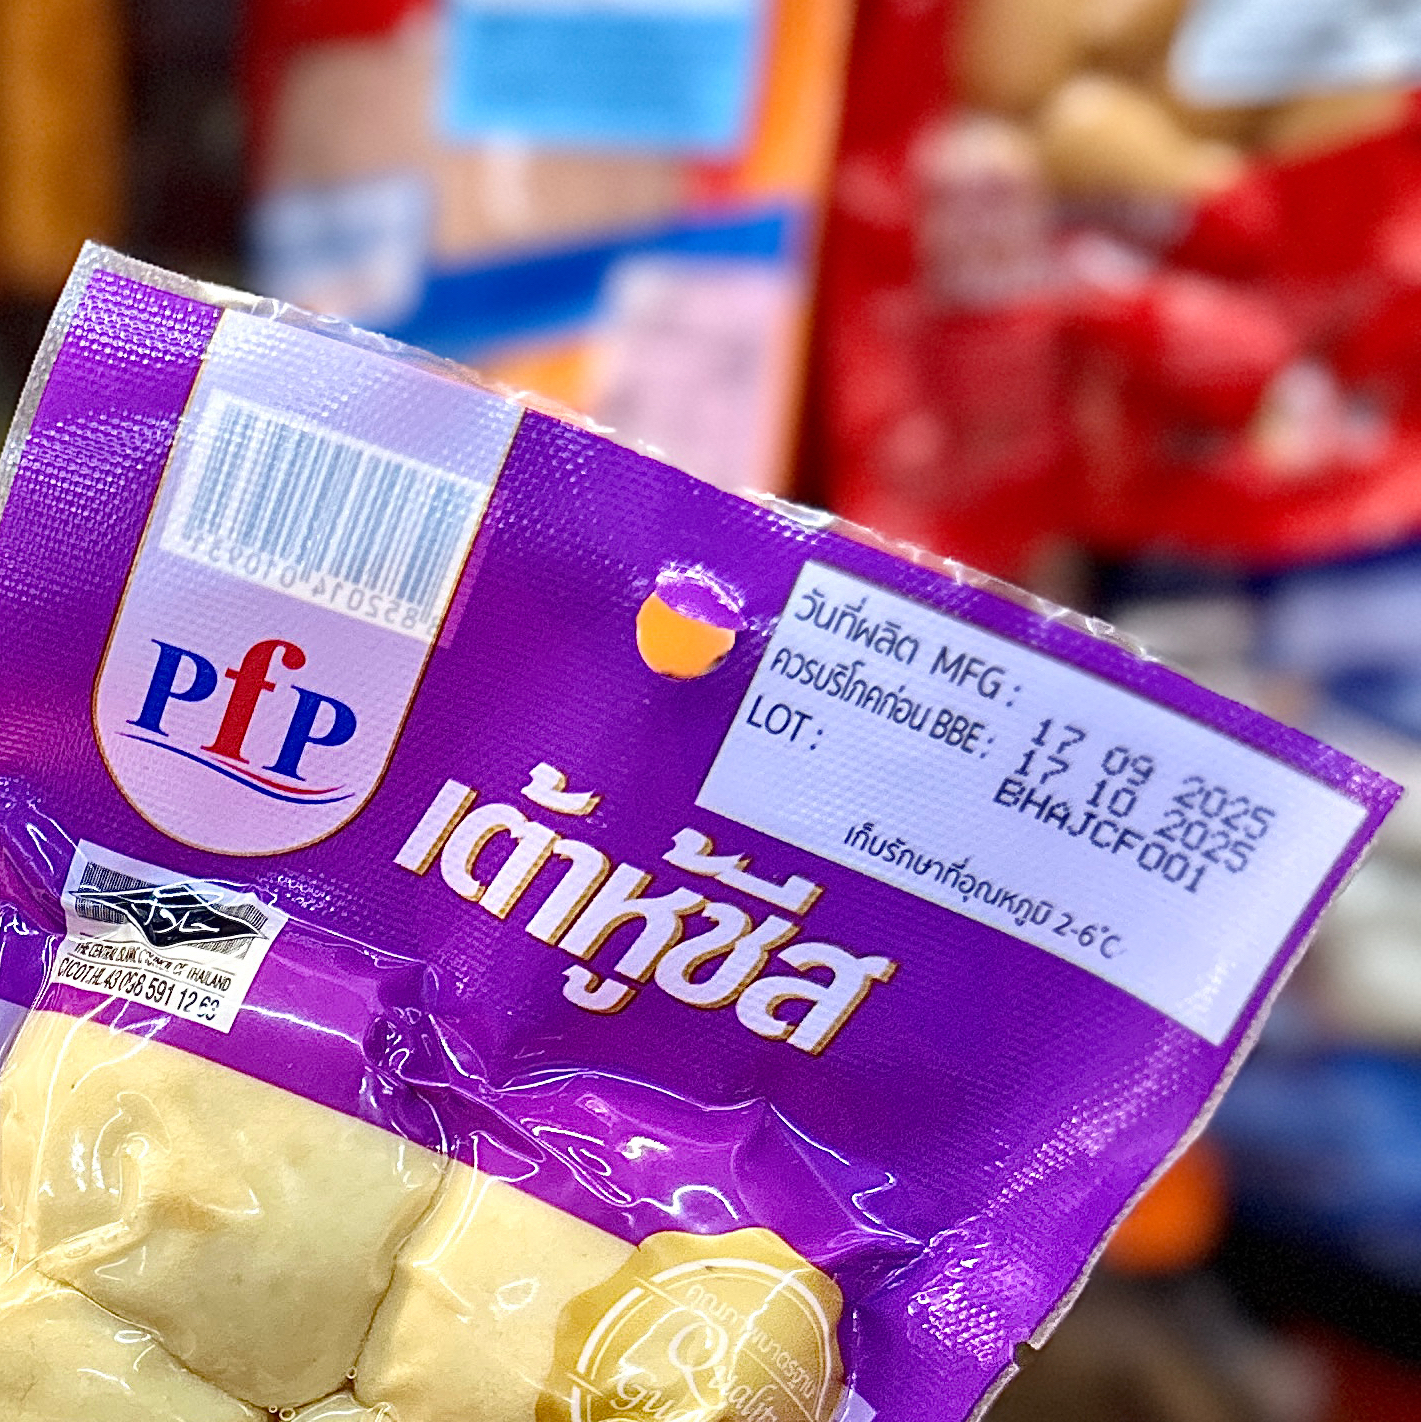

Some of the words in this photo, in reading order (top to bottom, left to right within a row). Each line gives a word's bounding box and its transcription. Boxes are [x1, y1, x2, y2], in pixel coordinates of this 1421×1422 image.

[794, 588, 920, 665] วันที่ผลิต
[126, 638, 358, 782] PfP
[769, 647, 932, 732] ควรบริโภคก่อน
[992, 776, 1208, 893] BHAJCF001
[1014, 749, 1070, 785] 17
[1086, 779, 1138, 818] 10
[1153, 809, 1256, 873] 2025
[1031, 718, 1087, 754] 17
[1101, 746, 1155, 787] 09
[1172, 775, 1276, 840] 2025
[393, 761, 898, 1058] เต้าหู้ชีส
[844, 822, 1054, 927] เก็บรักษาที่อุณหภูมิ
[145, 977, 175, 1007] 591
[176, 987, 198, 1013] 12
